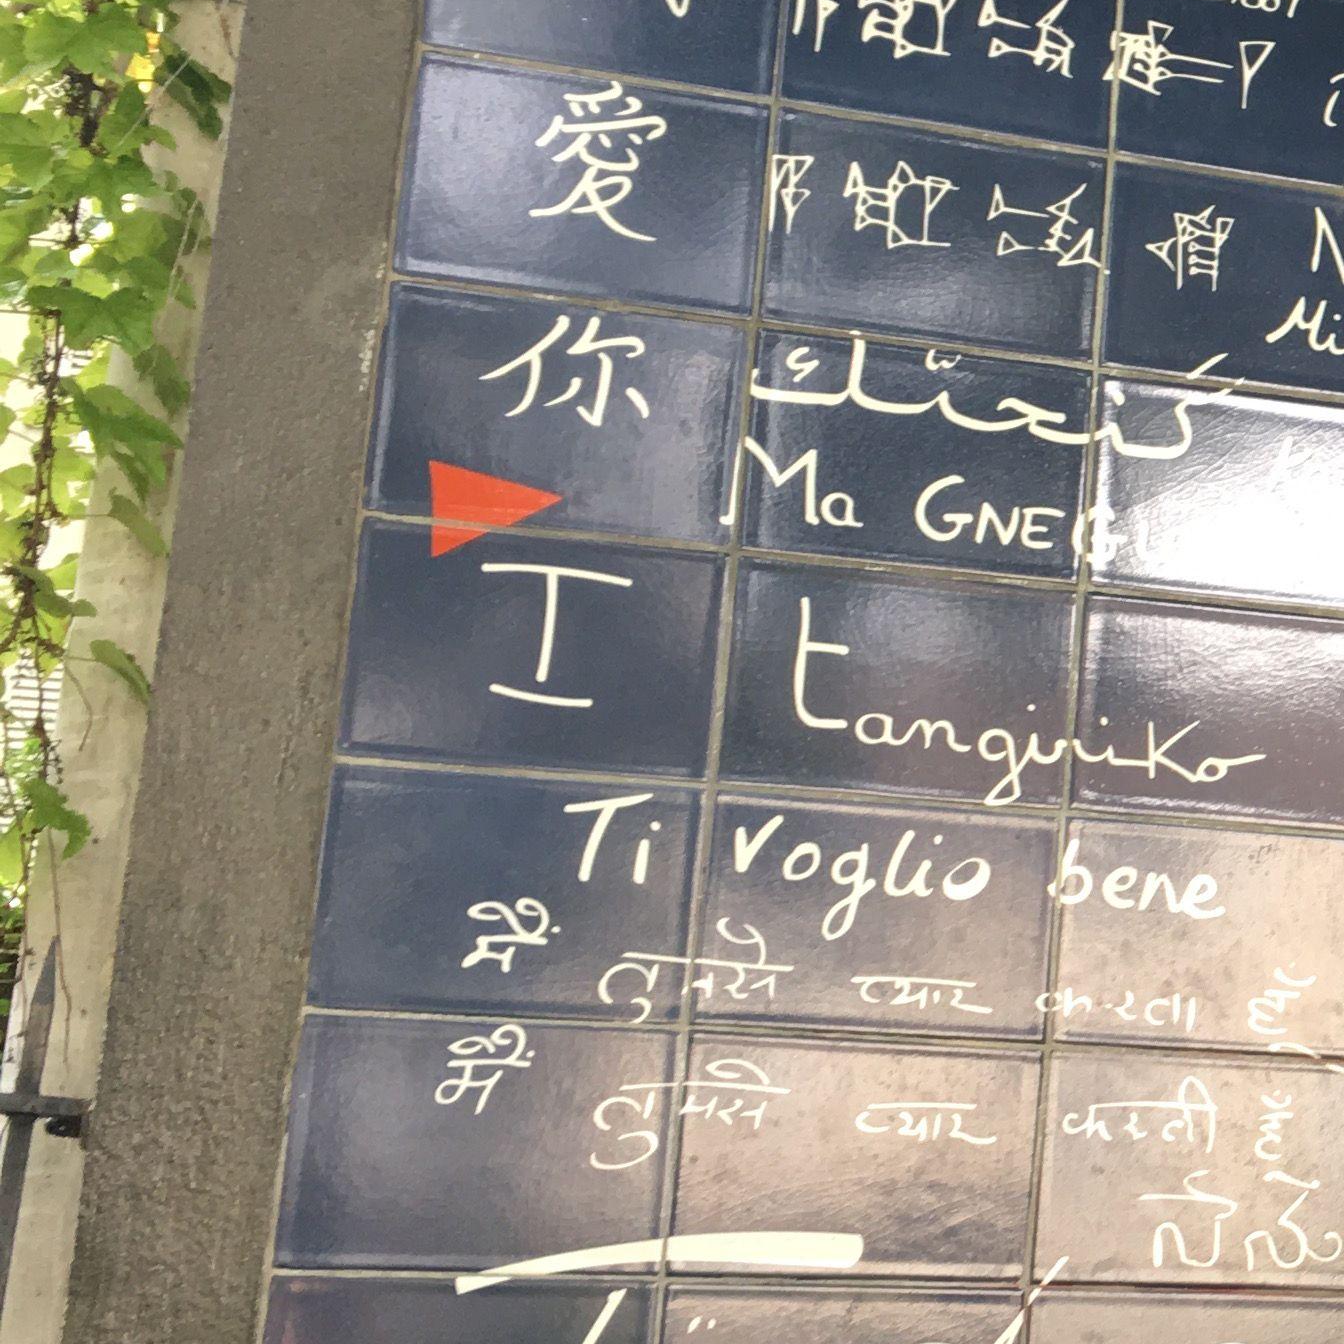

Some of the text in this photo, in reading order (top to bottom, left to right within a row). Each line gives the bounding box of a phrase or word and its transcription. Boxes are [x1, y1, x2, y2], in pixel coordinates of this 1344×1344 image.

[529, 80, 669, 243] 愛
[479, 314, 650, 427] 你
[563, 792, 1227, 943] Ti voglio bene
